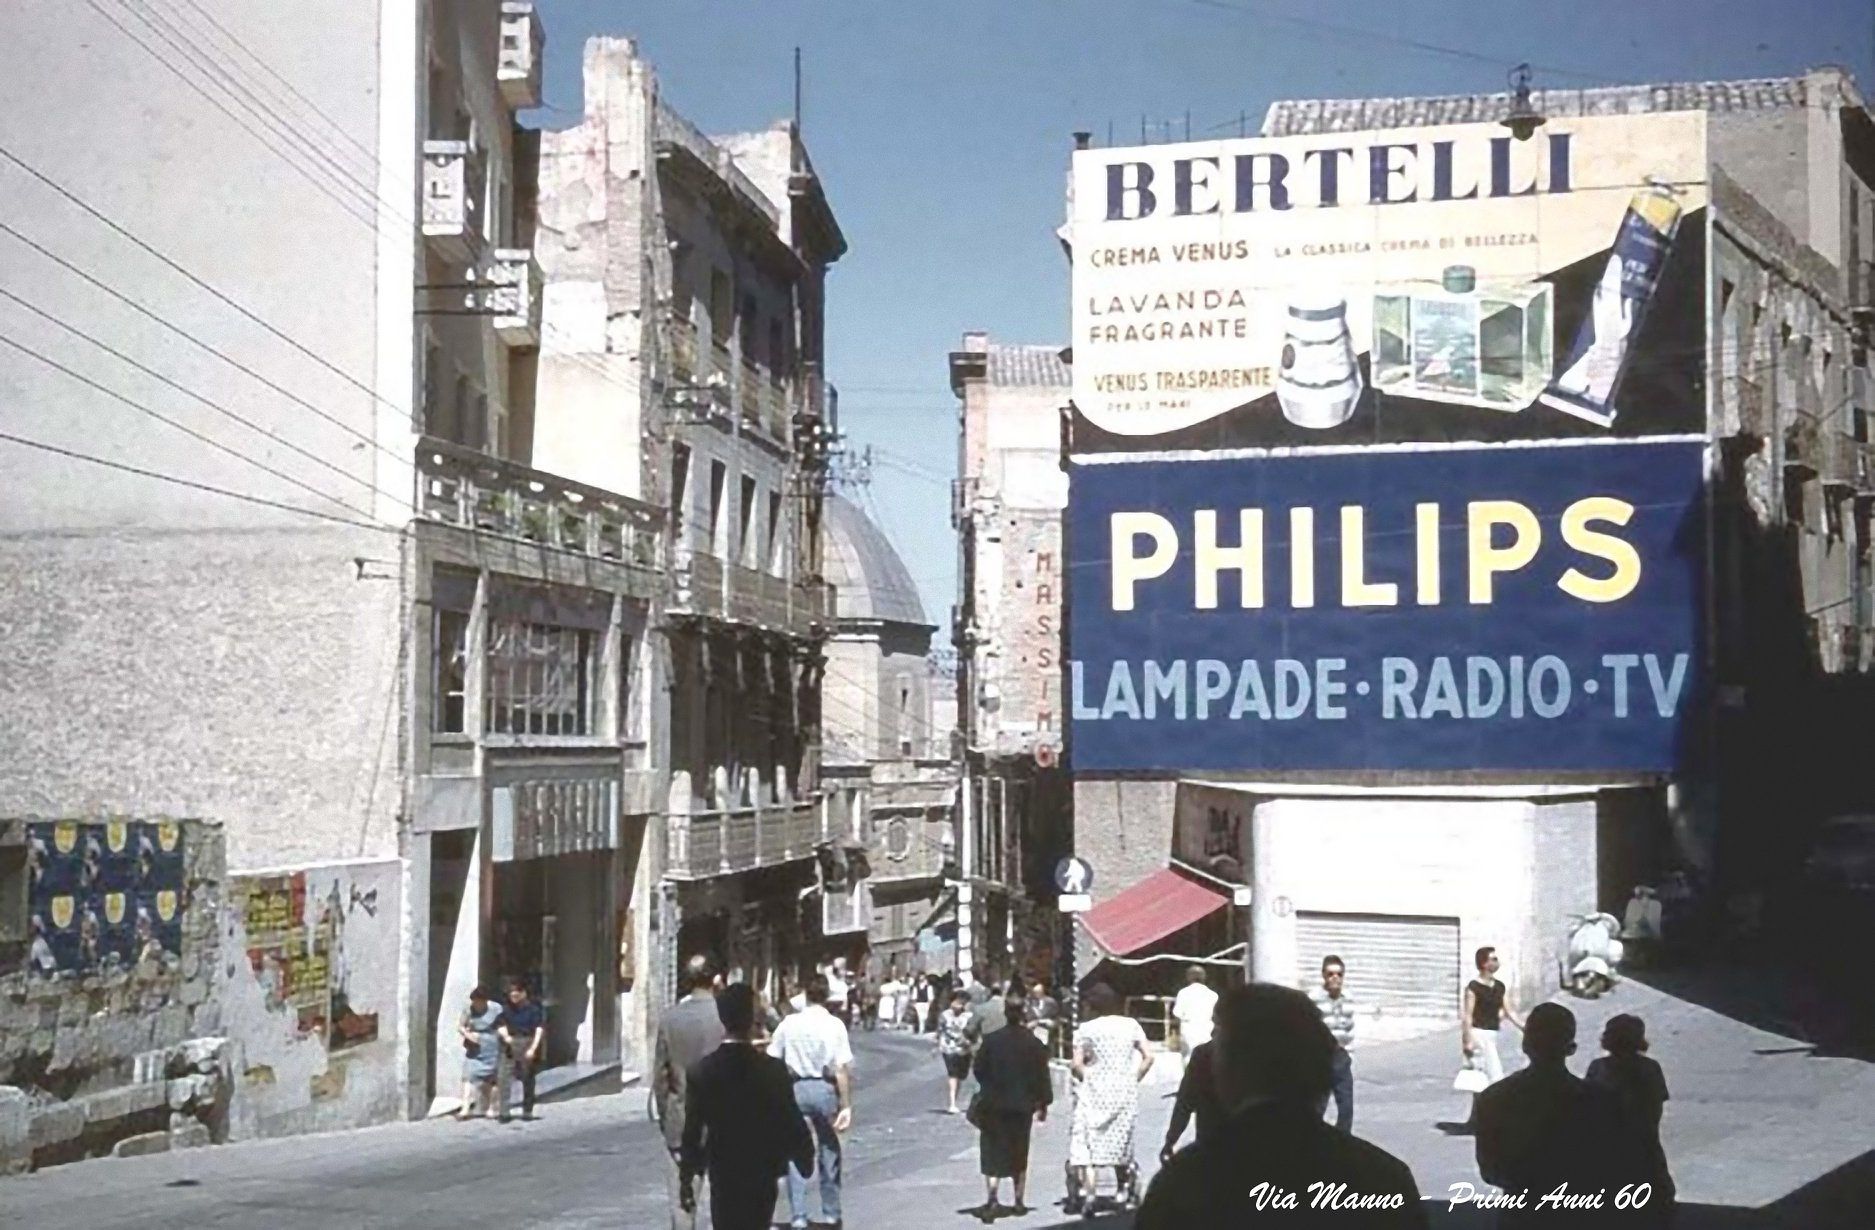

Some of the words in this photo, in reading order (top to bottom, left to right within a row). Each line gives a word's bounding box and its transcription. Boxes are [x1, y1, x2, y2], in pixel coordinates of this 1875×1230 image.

[1104, 132, 1573, 222] BERTELLI
[1090, 243, 1161, 269] CREMA
[1172, 240, 1250, 264] VENUS
[1274, 246, 1292, 258] LA
[1301, 242, 1372, 257] CLASSICA
[1380, 239, 1431, 251] CREMA
[1464, 232, 1539, 248] BELLEZZA
[1089, 289, 1247, 316] LAVANDA
[1089, 318, 1248, 345] FRAGRANTE
[1094, 372, 1149, 393] VENUS
[1155, 366, 1272, 392] TRASPARENTE
[1110, 496, 1642, 612] PHILIPS
[1035, 551, 1053, 768] MASSIMO
[1071, 658, 1348, 721] LAMPADE
[1381, 654, 1572, 719] RADIO
[1601, 653, 1690, 719] TV
